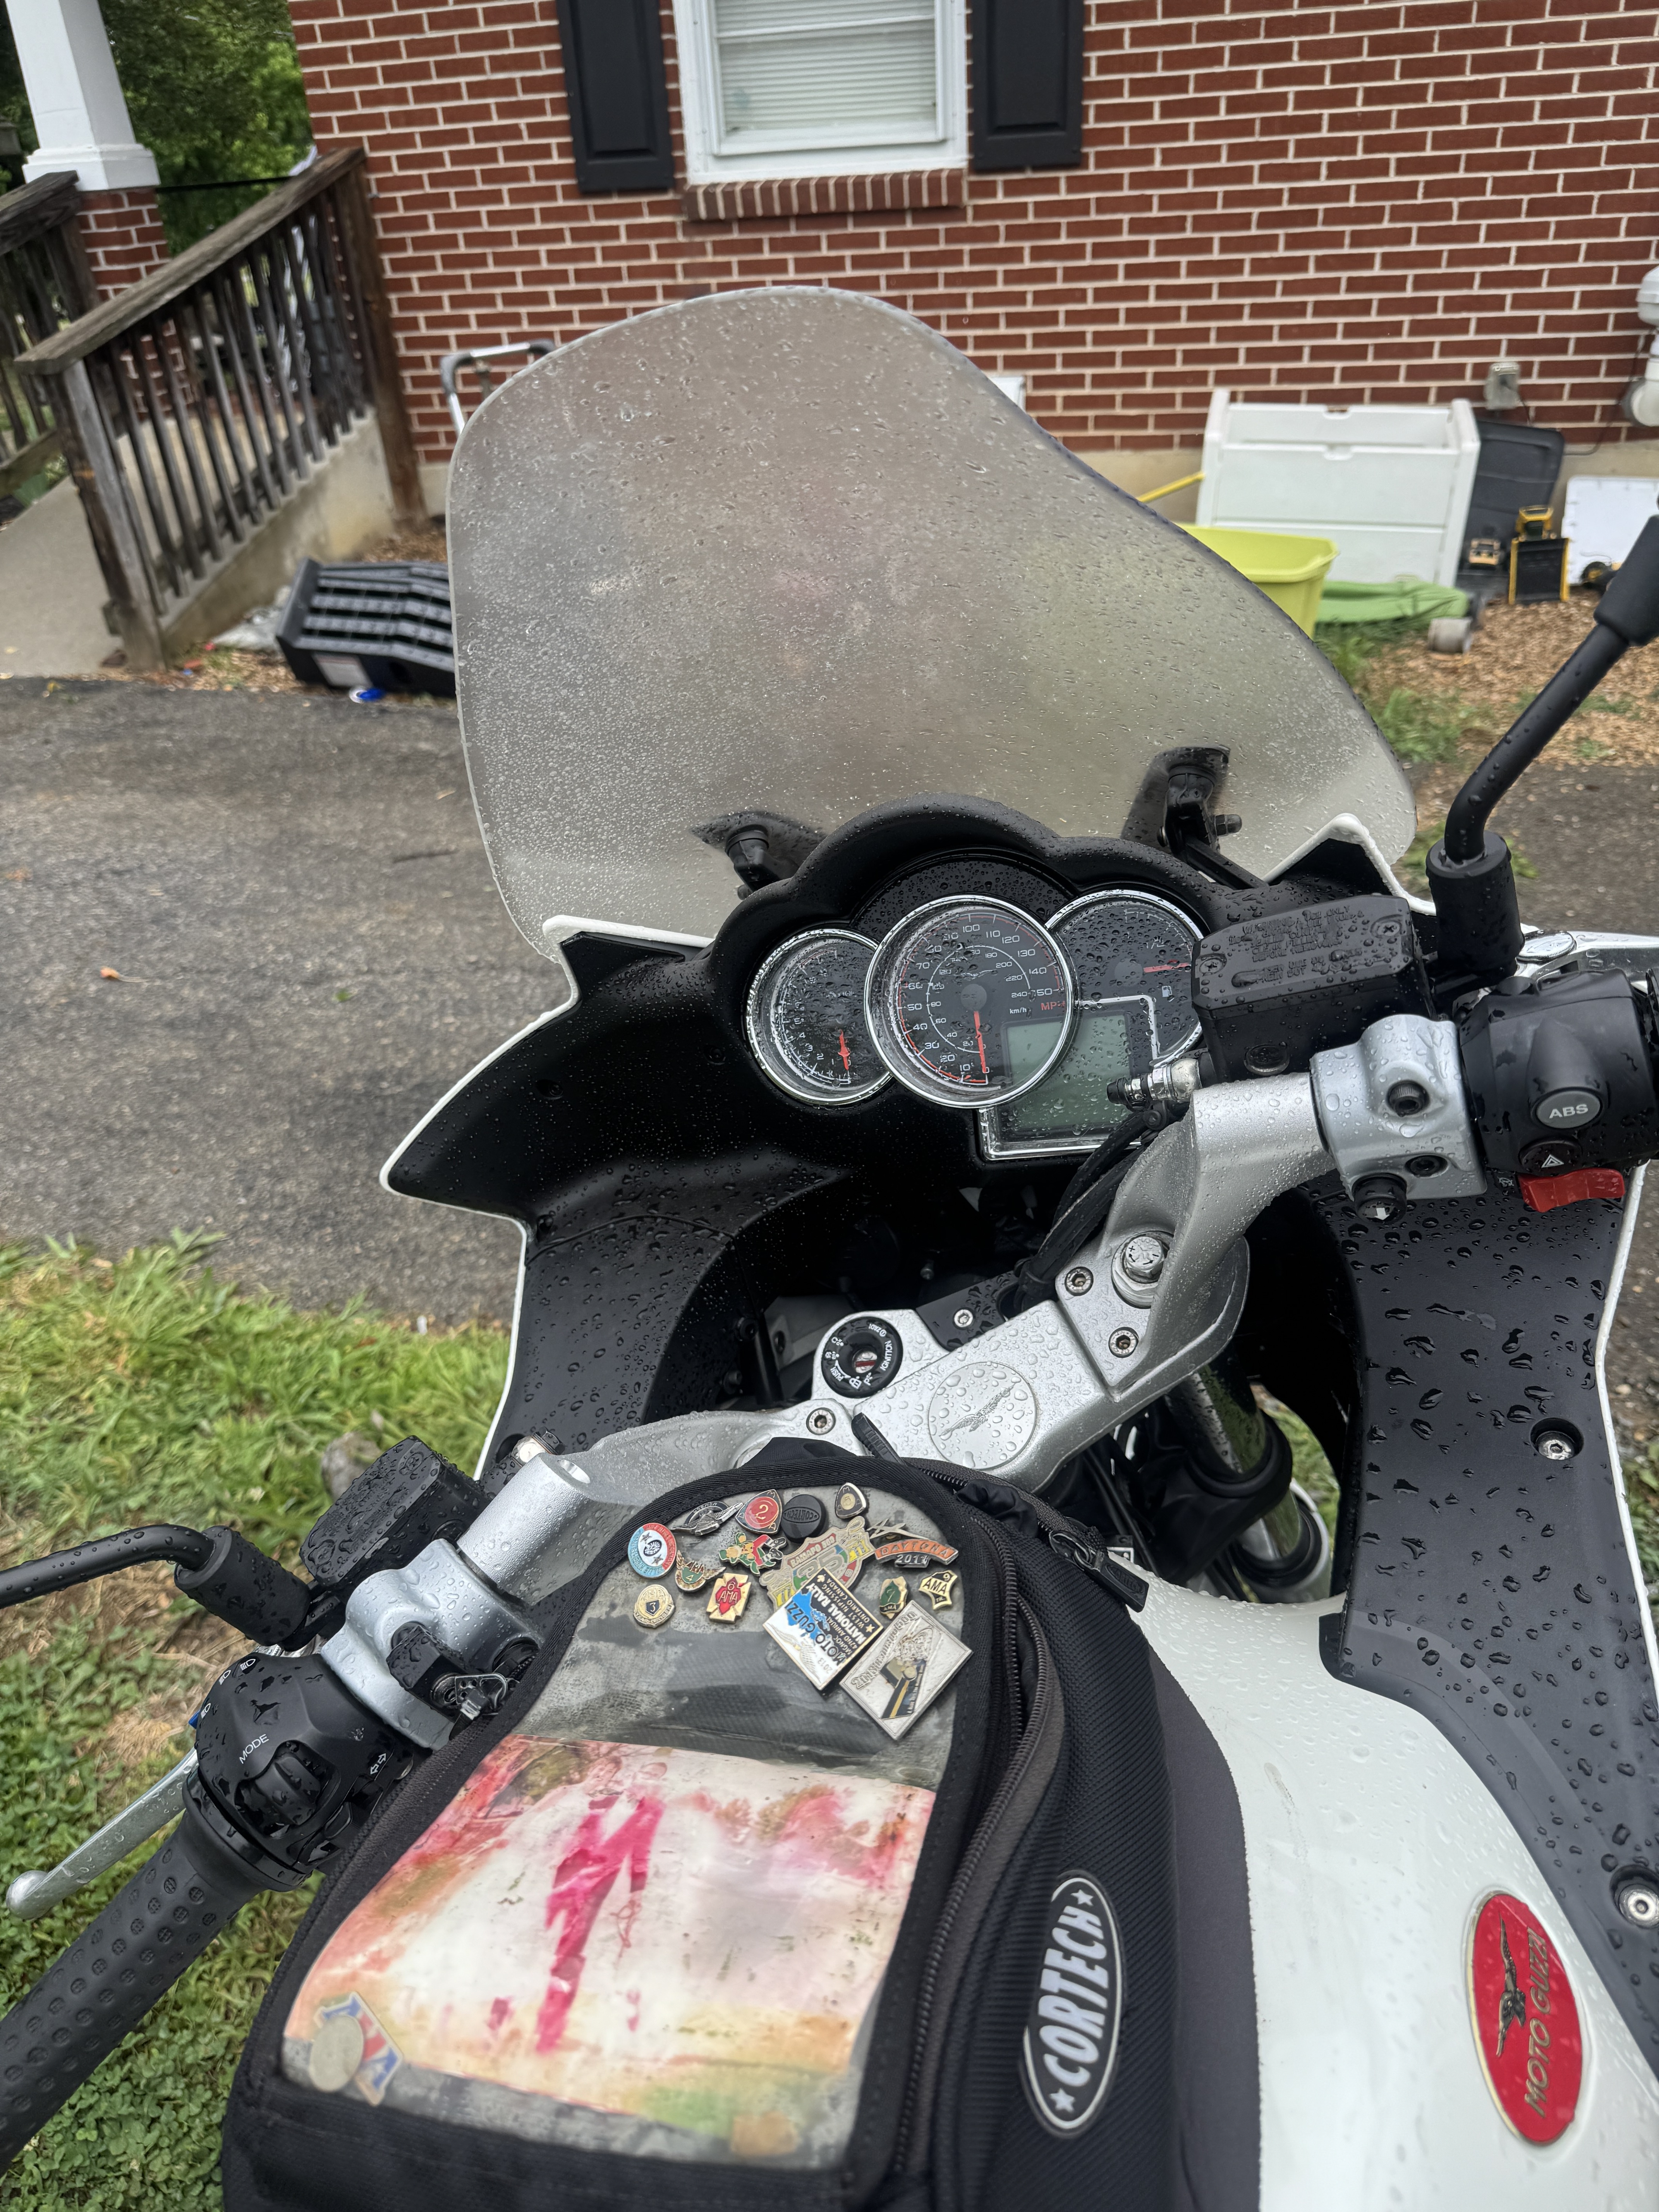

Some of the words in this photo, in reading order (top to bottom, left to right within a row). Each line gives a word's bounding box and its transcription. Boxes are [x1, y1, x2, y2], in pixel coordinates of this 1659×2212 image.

[963, 924, 980, 933] 100
[986, 930, 1000, 938] 110
[1002, 935, 1020, 944] 120
[1018, 949, 1036, 957] 130
[925, 1042, 939, 1050] 30
[1549, 1104, 1588, 1119] ABS
[880, 1340, 893, 1371] IGNITION
[830, 1367, 844, 1381] PUSH
[755, 1504, 768, 1520] 2
[787, 1510, 814, 1521] CORTECH
[790, 1544, 821, 1567] RAMAPO
[881, 1541, 949, 1558] DAYTONA
[728, 1581, 736, 1590] 6
[826, 1578, 847, 1600] CANADA
[923, 1578, 947, 1595] AMA
[718, 1590, 738, 1603] AMA
[807, 1583, 831, 1607] RALLY
[822, 1584, 848, 1612] NIPISSING
[886, 1589, 895, 1602] 7
[650, 1604, 656, 1612] 3
[785, 1600, 816, 1633] GUZZI
[847, 1600, 870, 1623] ONTARIO
[828, 1603, 867, 1645] NATIONAL
[848, 1612, 864, 1628] WEST
[843, 1632, 857, 1649] 42ND
[815, 1633, 848, 1666] MOTO
[817, 1657, 833, 1674] 2013
[239, 1734, 269, 1764] MODE
[1527, 1926, 1550, 2014] GUZZI
[1038, 1905, 1109, 2087] CORTECH
[1524, 2018, 1550, 2118] MOTO
